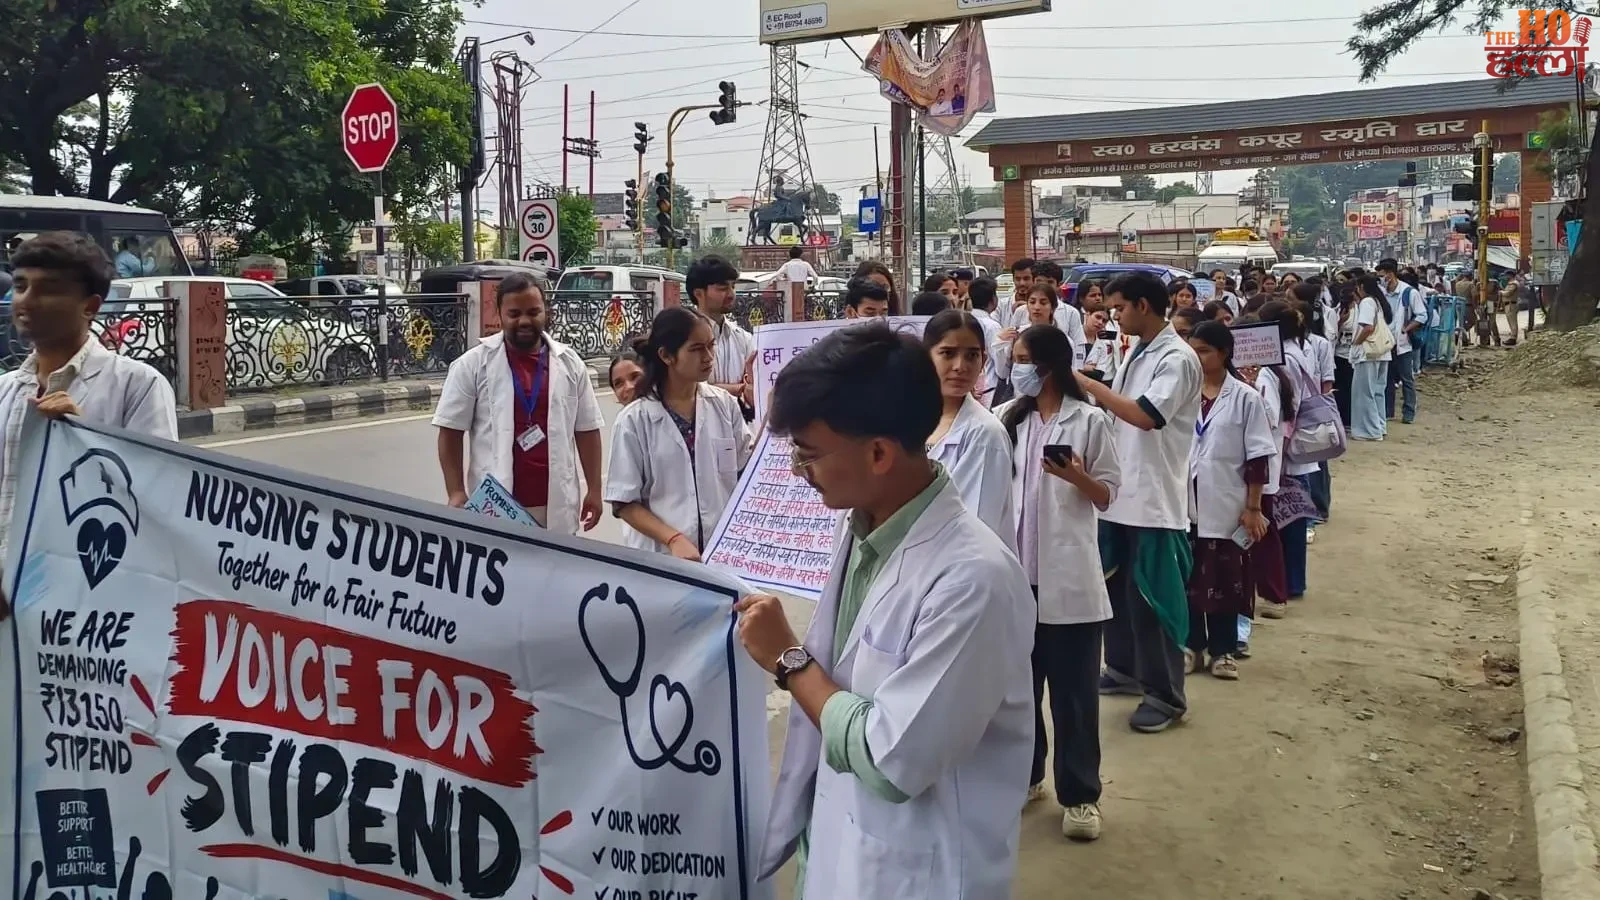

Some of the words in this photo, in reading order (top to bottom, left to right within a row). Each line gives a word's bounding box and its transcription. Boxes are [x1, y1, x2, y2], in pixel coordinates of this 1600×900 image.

[348, 111, 392, 145] STOP
[1237, 132, 1304, 149] कपूर
[1415, 119, 1469, 136] द्वार
[531, 222, 545, 234] 30
[763, 346, 784, 365] हम
[185, 470, 320, 551] NURSING
[326, 508, 509, 607] STUDENTS
[217, 541, 291, 591] Together
[291, 562, 321, 607] for
[323, 588, 339, 610] a
[342, 577, 384, 623] Fair
[387, 590, 458, 645] Future
[40, 608, 77, 647] WE
[77, 609, 135, 654] ARE
[37, 651, 128, 688] DEMANDING
[199, 610, 358, 726] VOICE
[376, 658, 496, 768] FOR
[39, 682, 124, 734] ₹13150
[45, 731, 133, 775] STIPEND
[59, 800, 89, 816] BETTR
[176, 721, 522, 898] STIPEND
[608, 809, 635, 835] OUR
[637, 812, 682, 837] WORK
[66, 845, 93, 861] BETTE
[611, 847, 637, 875] OUR
[641, 851, 726, 880] DEDICATION
